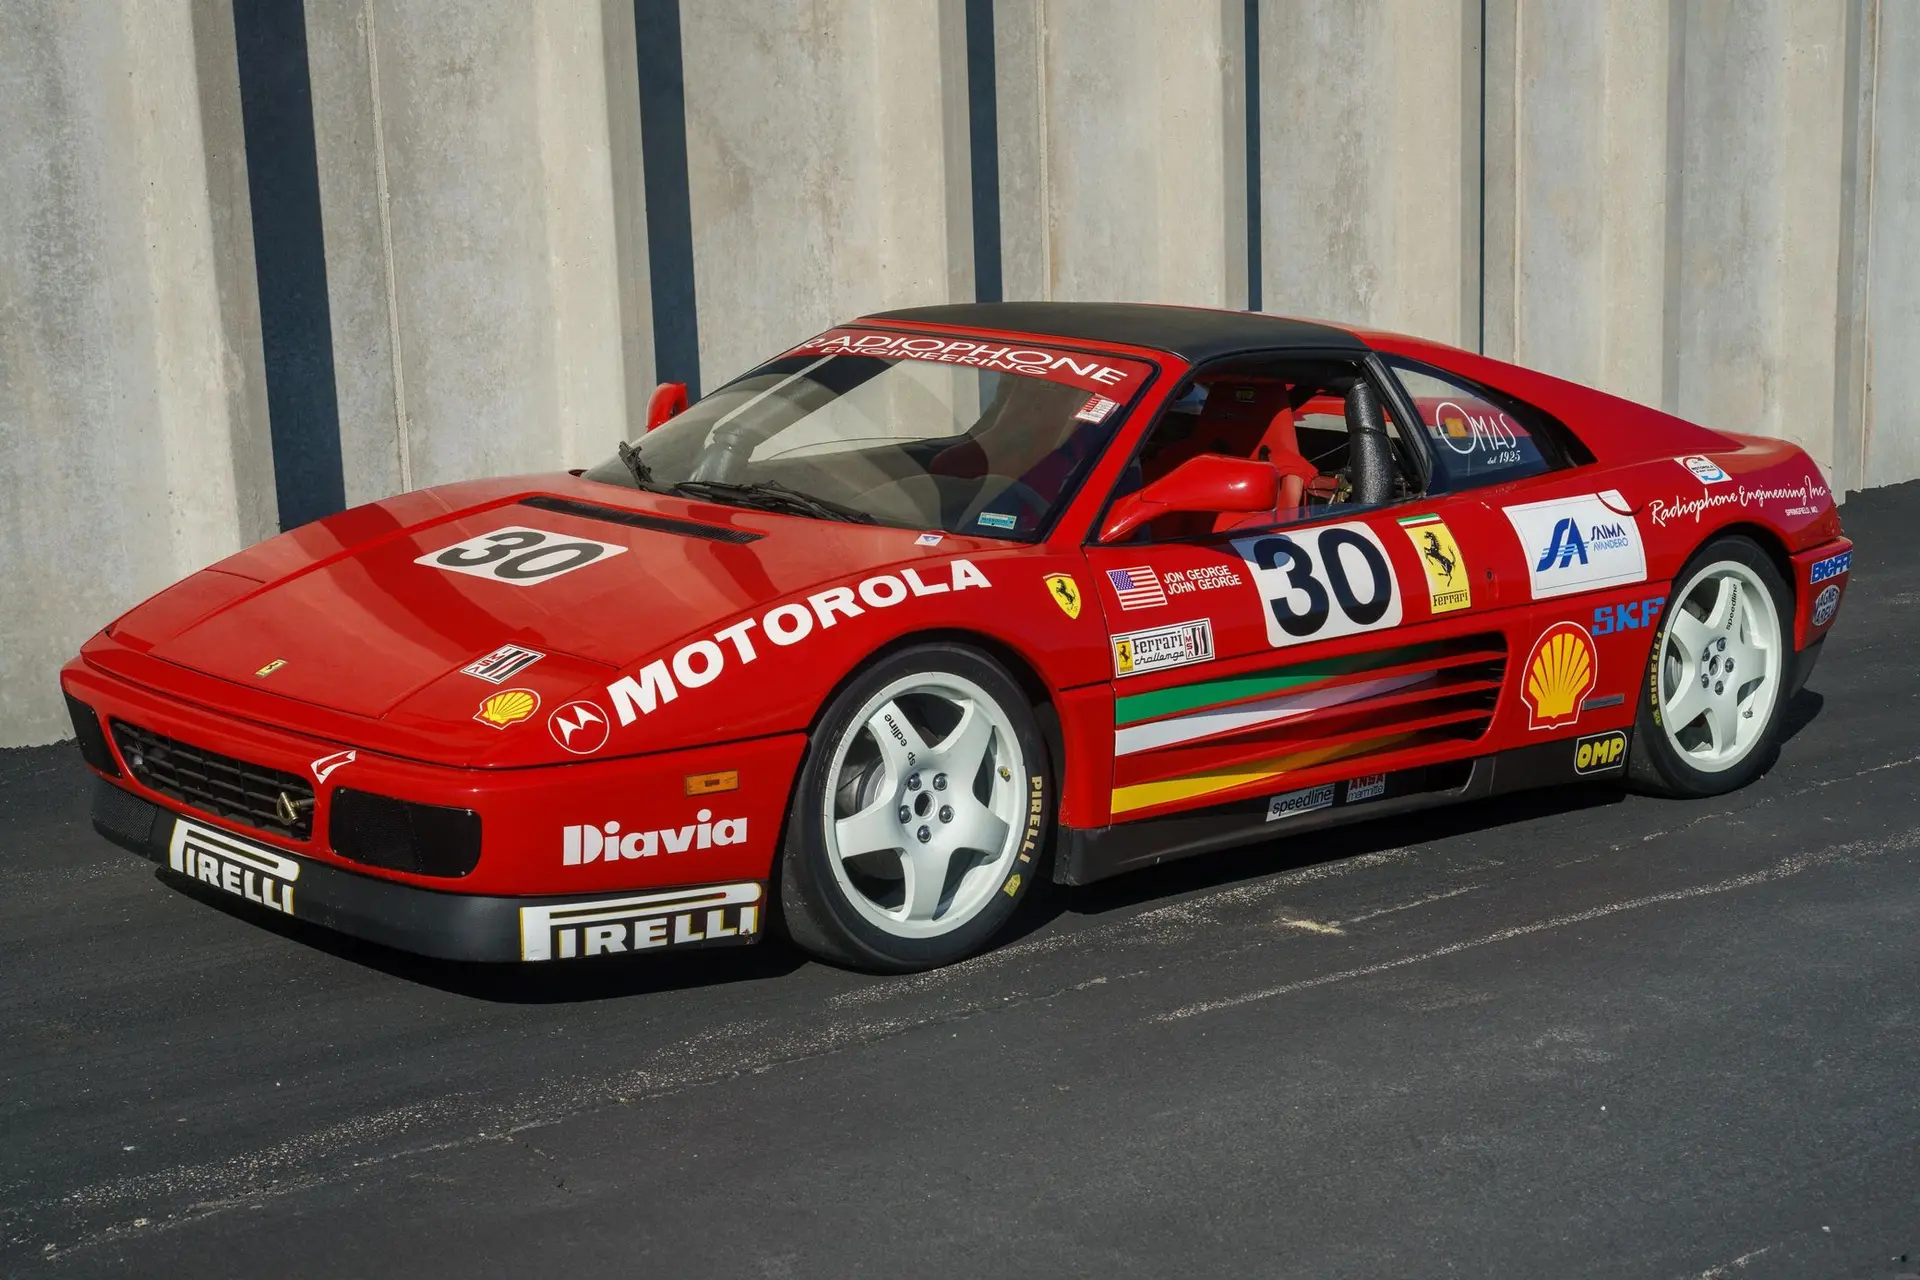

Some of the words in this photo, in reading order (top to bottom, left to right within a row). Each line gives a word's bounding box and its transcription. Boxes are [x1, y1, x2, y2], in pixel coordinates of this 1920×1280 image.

[820, 347, 1048, 376] ENGINEERING
[1436, 402, 1517, 454] OMAS
[1499, 450, 1520, 463] 1925
[1649, 488, 1738, 527] Radiophone
[1738, 484, 1807, 506] Engineering
[436, 531, 605, 579] 30
[1593, 537, 1629, 551] AVANDERO
[1164, 571, 1185, 584] JON
[1186, 565, 1232, 580] GEORGE
[1168, 581, 1196, 595] JOHN
[1198, 574, 1242, 590] GEORGE
[1253, 527, 1392, 637] 30
[1432, 589, 1469, 607] Ferrari
[1592, 597, 1665, 636] SKF
[1726, 583, 1738, 630] speedline
[606, 558, 992, 728] MOTOROLA
[1131, 630, 1183, 655] Ferrari
[1135, 650, 1185, 666] challenge
[1651, 631, 1663, 705] PIRELLI
[1576, 737, 1625, 769] OMP
[1019, 775, 1043, 864] PIRELLI
[1272, 787, 1332, 817] speedline
[562, 808, 748, 867] Diavia
[169, 818, 300, 916] PIRELLI
[519, 882, 762, 962] PIRELLI
